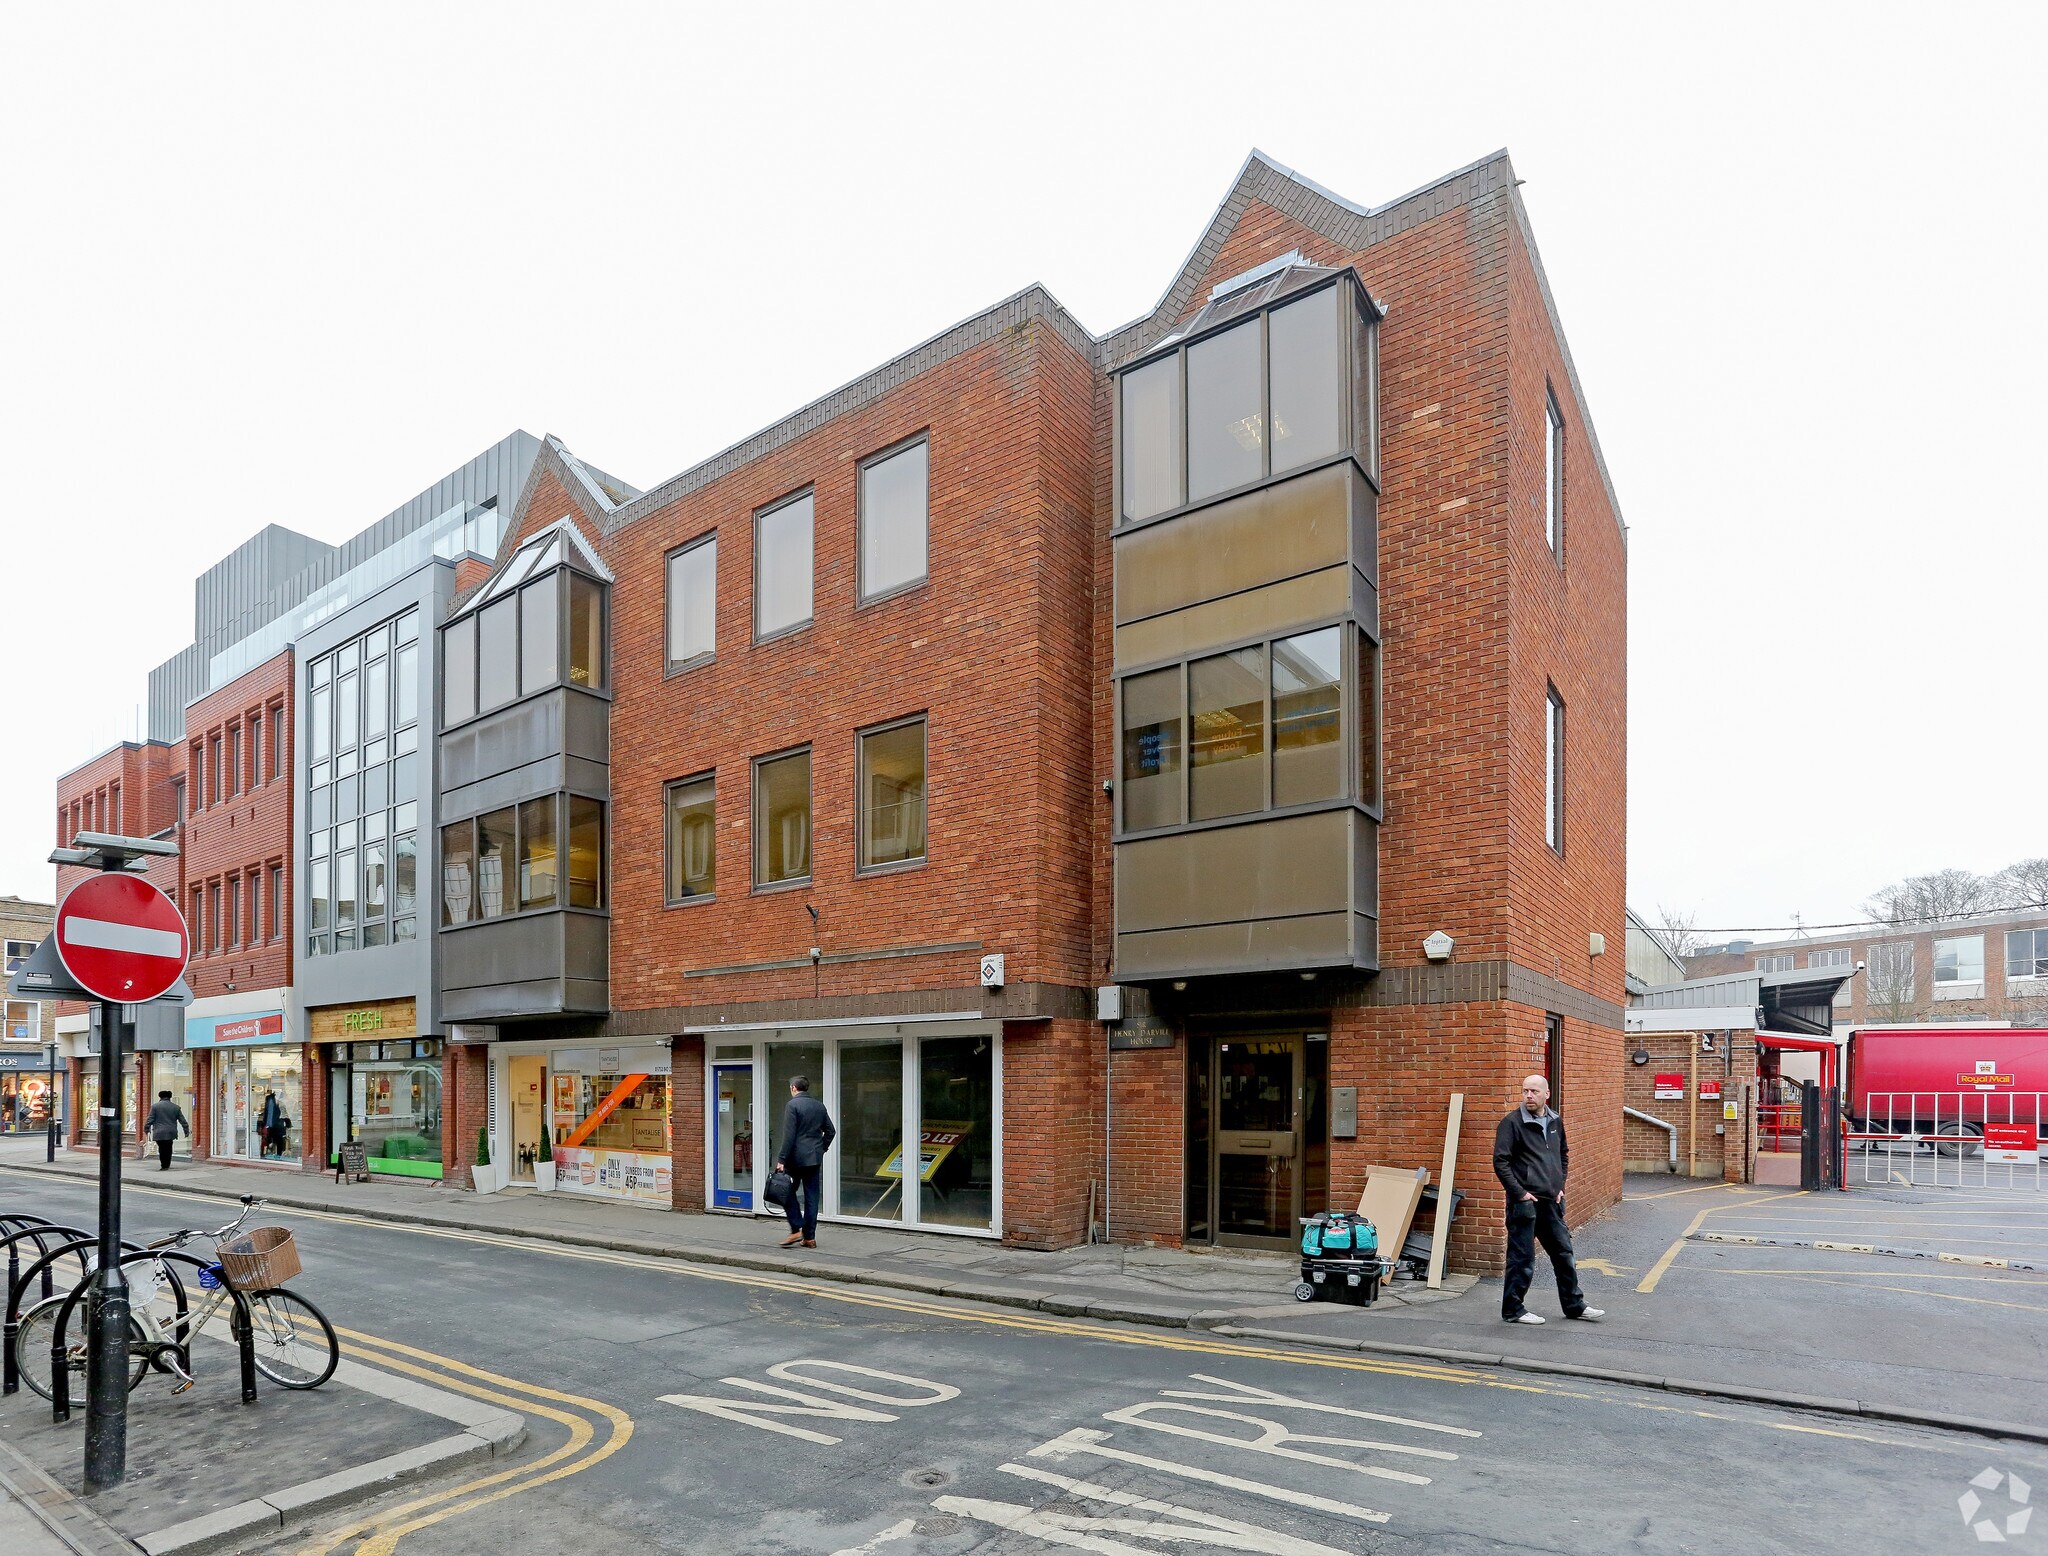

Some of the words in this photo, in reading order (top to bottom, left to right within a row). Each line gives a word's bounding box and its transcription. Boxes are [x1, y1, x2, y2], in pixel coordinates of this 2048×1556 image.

[344, 1010, 383, 1031] FRESH
[222, 1028, 232, 1036] Save
[238, 1024, 254, 1034] Children
[1114, 1030, 1137, 1038] HENRY
[1130, 1037, 1153, 1045] HOUSE
[1961, 1075, 1988, 1084] Royal
[1989, 1075, 2010, 1083] Mail
[410, 1108, 443, 1130] RESH
[635, 1128, 661, 1137] TANTALISE
[931, 1133, 959, 1143] LET
[570, 1161, 580, 1170] FROM
[608, 1158, 620, 1170] ONLY
[624, 1165, 642, 1176] SUNBEDS
[642, 1167, 654, 1178] FROM
[625, 1175, 638, 1190] 45P
[643, 1182, 654, 1190] MINUTE
[655, 1359, 962, 1446] NO
